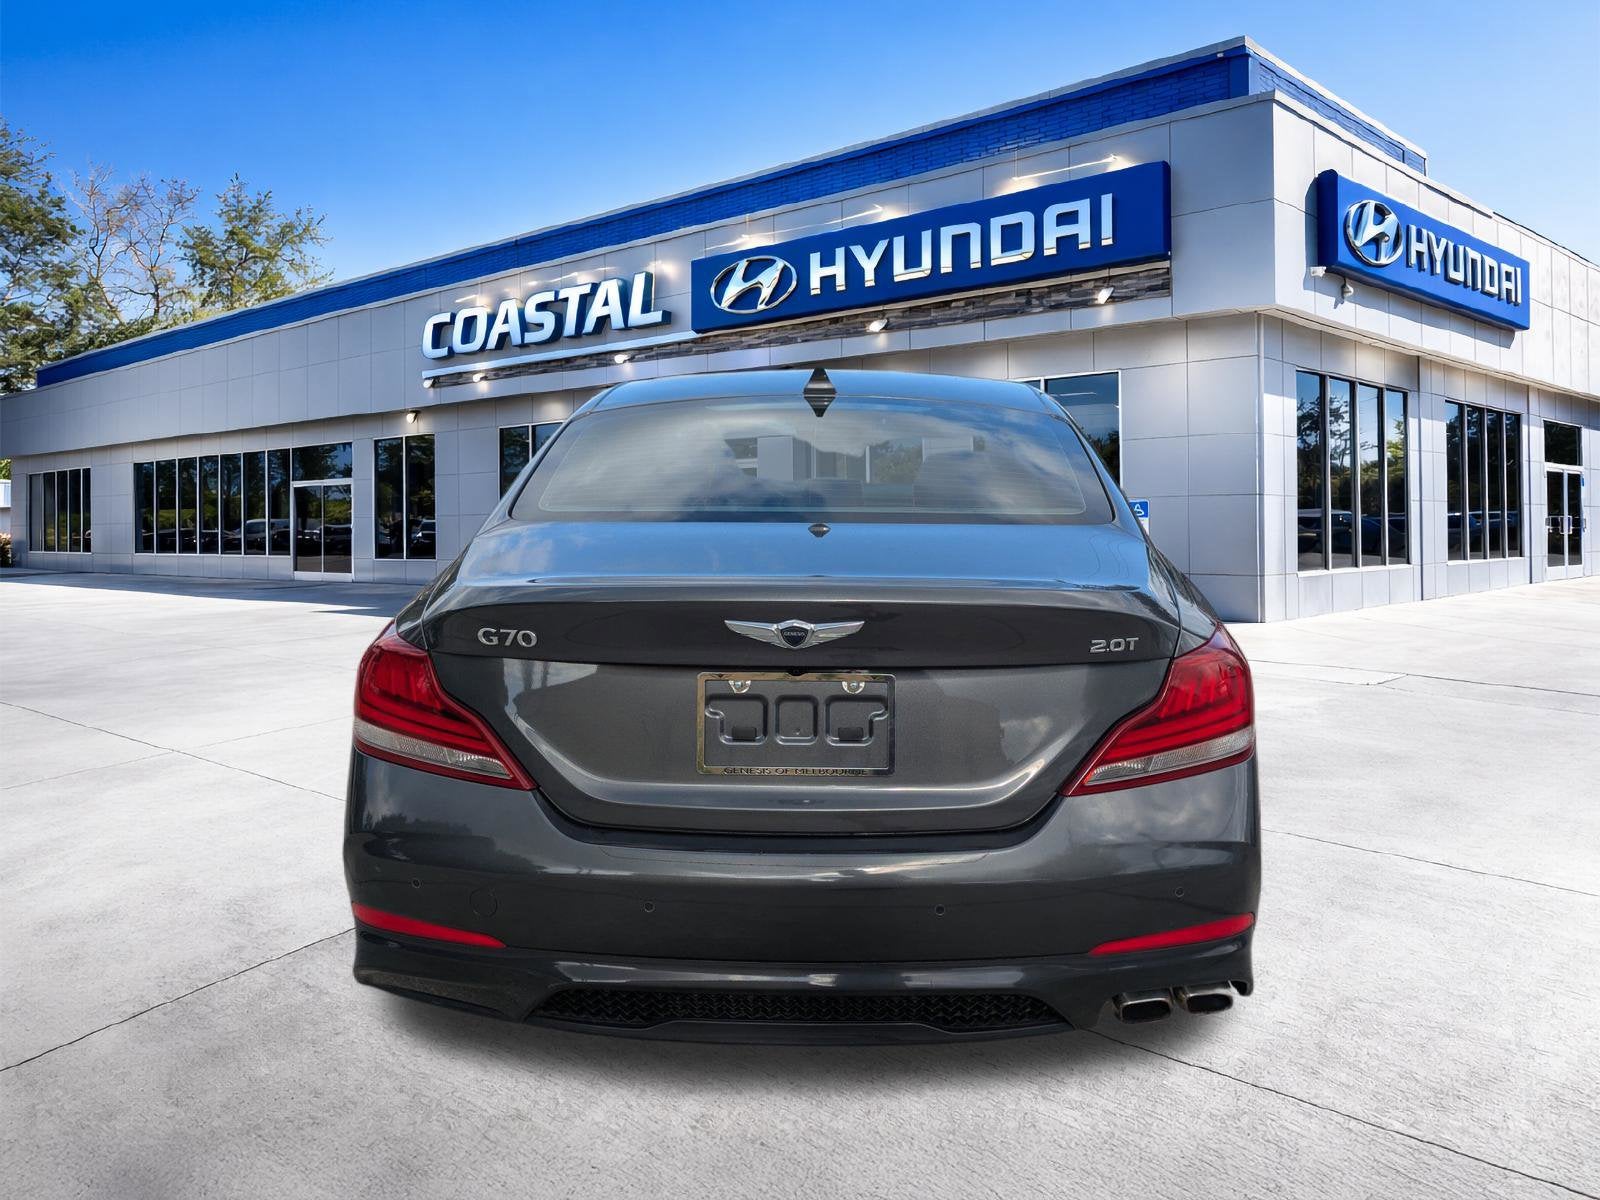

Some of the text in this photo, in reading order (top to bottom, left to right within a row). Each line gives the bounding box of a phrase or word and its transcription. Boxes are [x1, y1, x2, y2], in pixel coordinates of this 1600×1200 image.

[809, 192, 1113, 296] HYUNDAI
[1406, 224, 1522, 306] HYUNDAI
[422, 271, 668, 359] COASTAL
[477, 627, 538, 648] G70
[1089, 637, 1139, 653] 2.0T
[723, 766, 869, 777] GENESIS OF MELBOURNE
